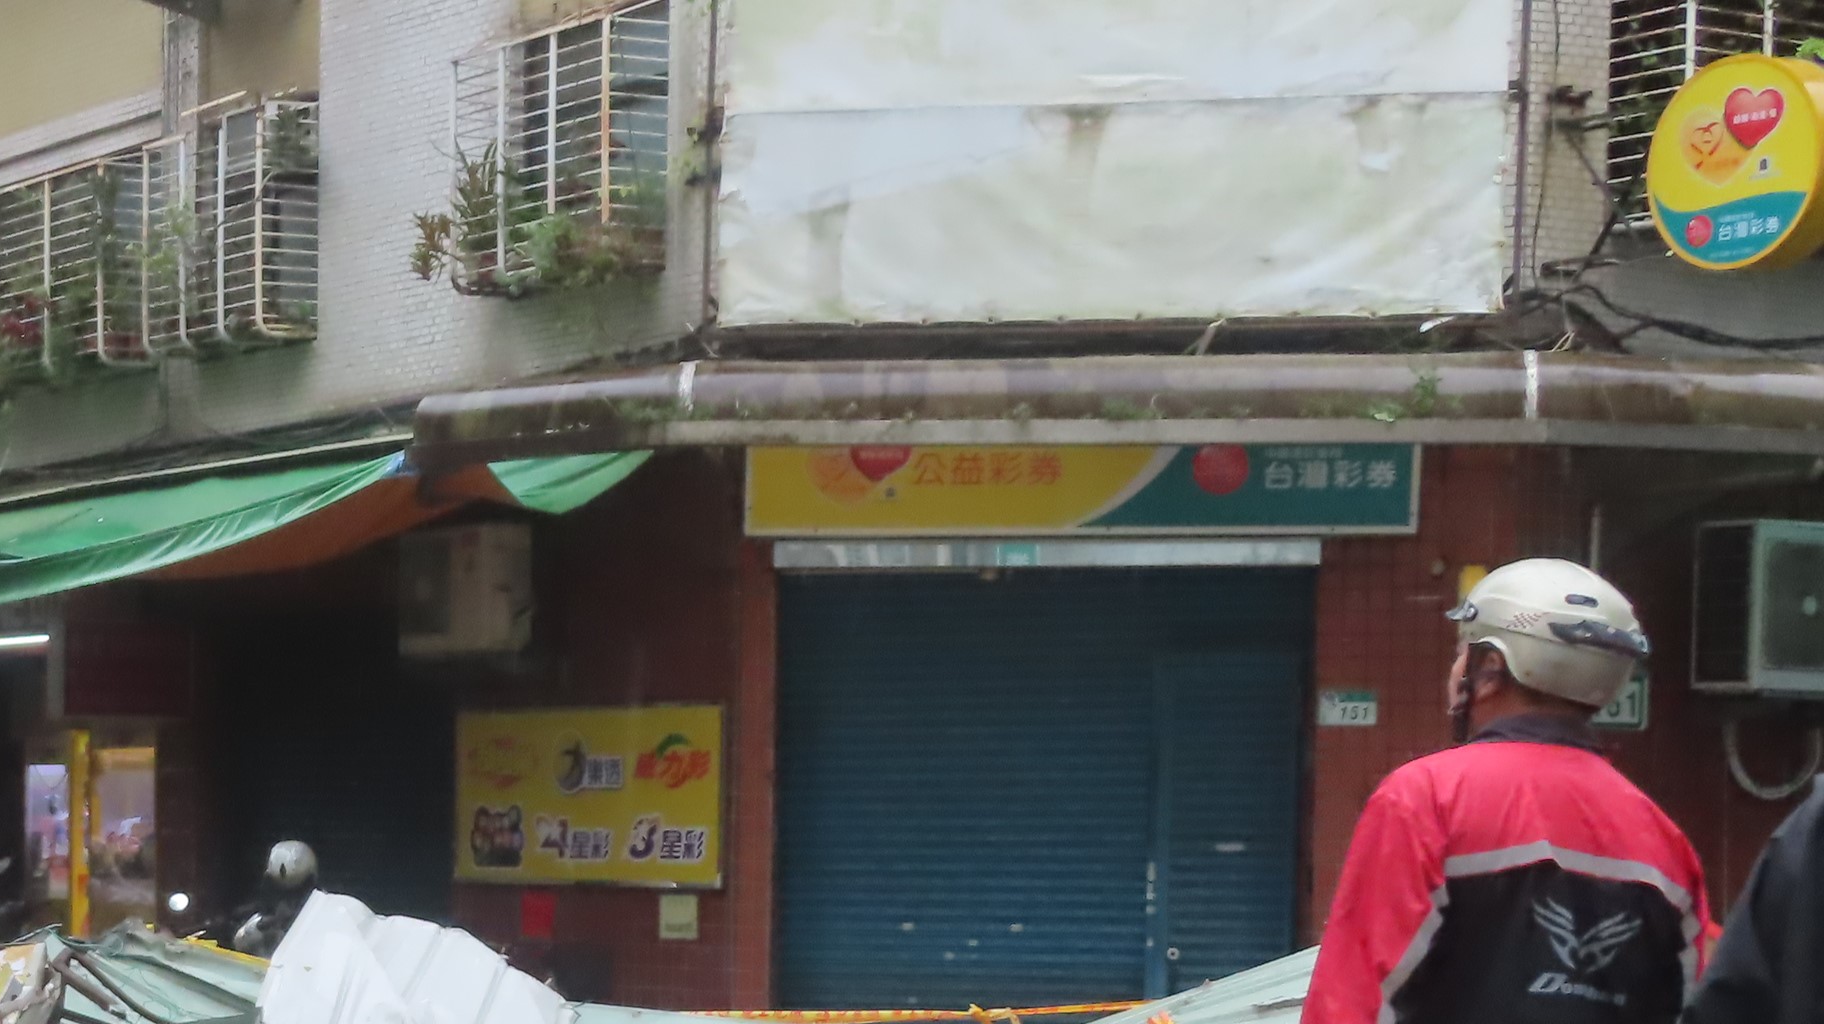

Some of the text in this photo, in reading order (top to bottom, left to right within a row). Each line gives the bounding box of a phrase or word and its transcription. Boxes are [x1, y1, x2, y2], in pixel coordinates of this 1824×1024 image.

[1718, 216, 1780, 241] 台灣彩券
[913, 451, 1063, 486] 公益彩券
[1264, 459, 1398, 490] 台灣彩券
[1339, 705, 1369, 721] 151
[629, 816, 705, 860] 3星彩
